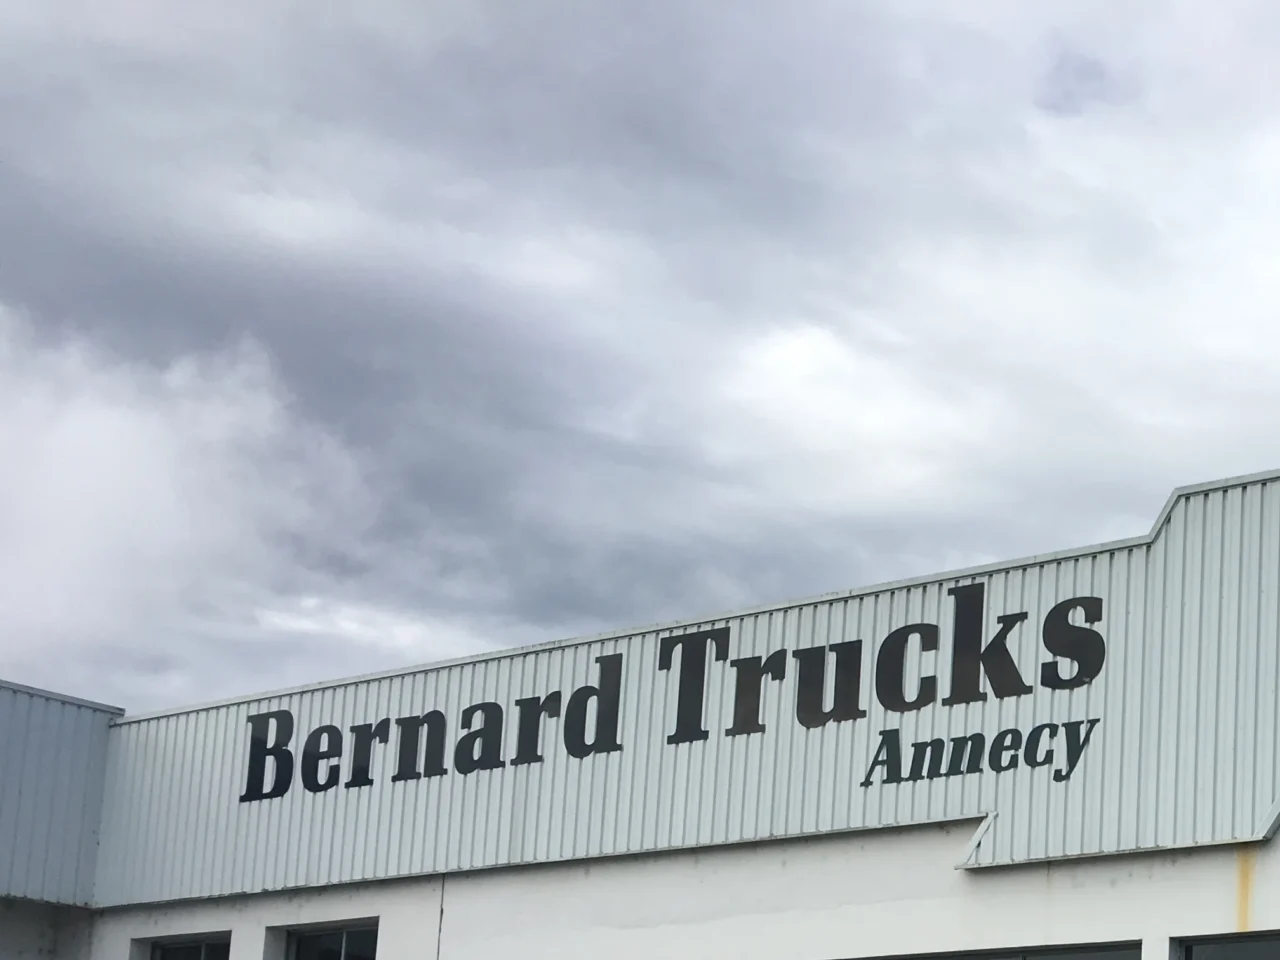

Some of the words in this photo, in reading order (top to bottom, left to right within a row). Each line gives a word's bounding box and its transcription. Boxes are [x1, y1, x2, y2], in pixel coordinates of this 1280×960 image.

[239, 653, 623, 803] Bernard
[658, 583, 1106, 746] Trucks
[860, 718, 1101, 788] Annecy
